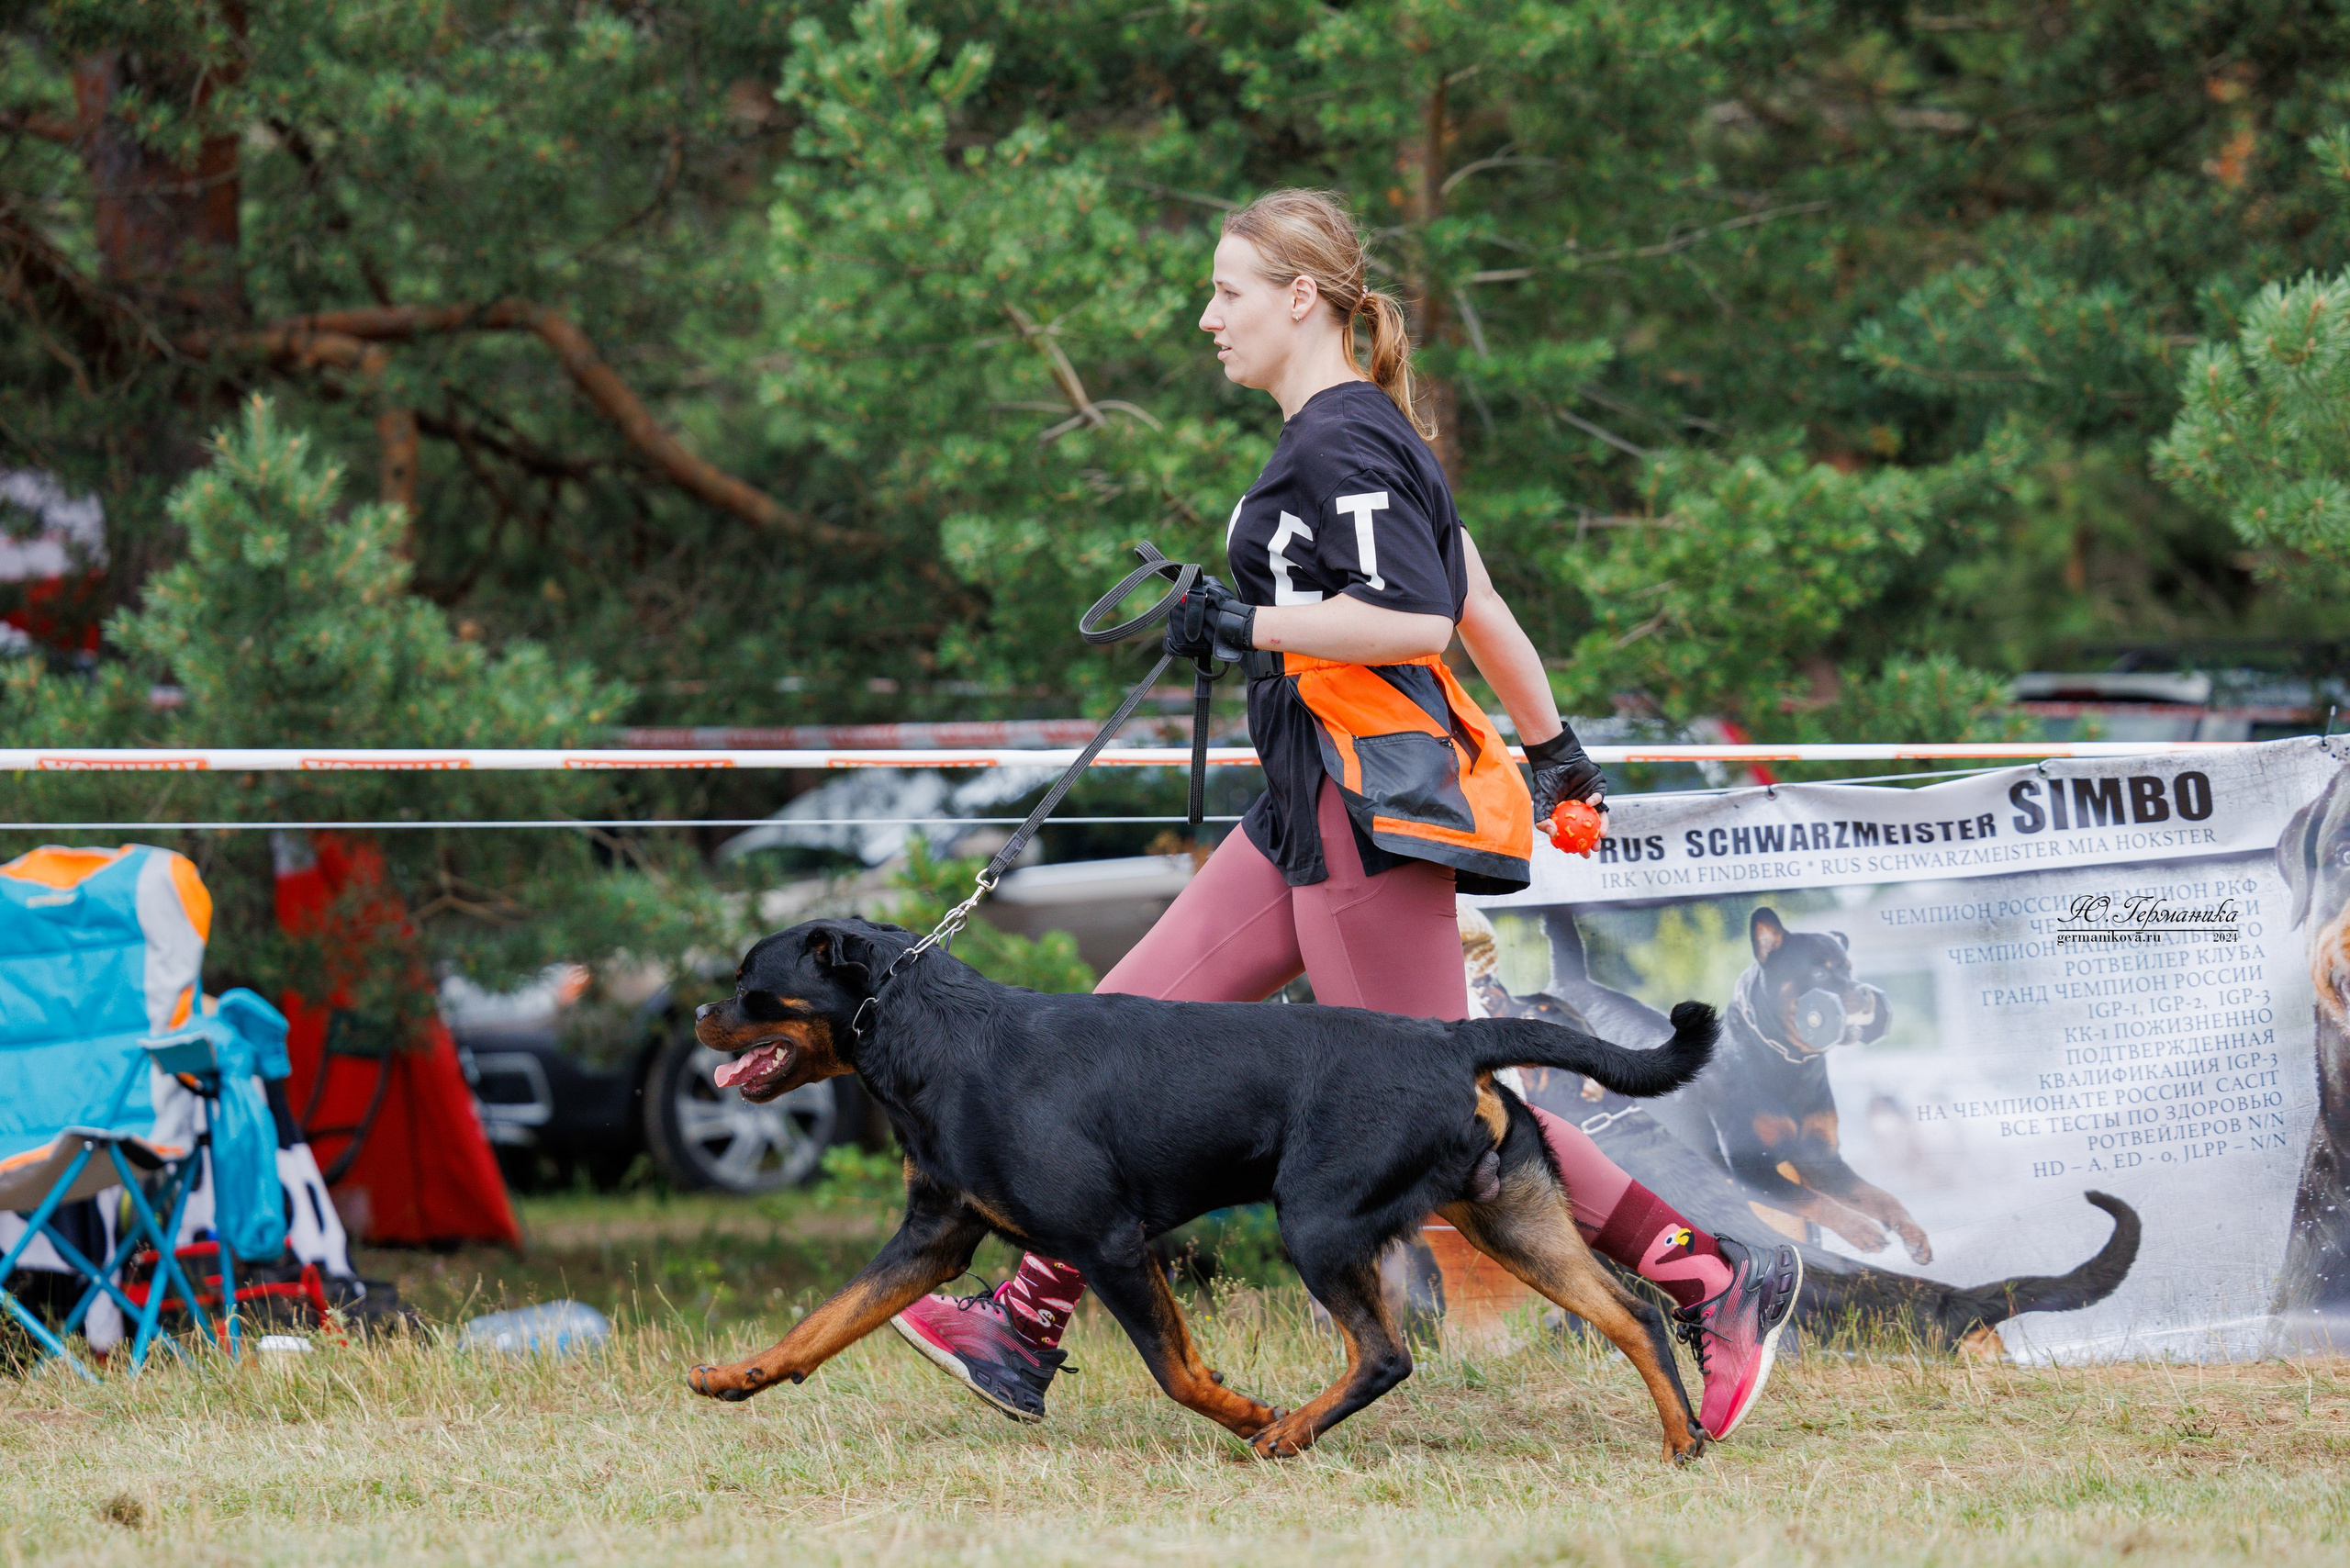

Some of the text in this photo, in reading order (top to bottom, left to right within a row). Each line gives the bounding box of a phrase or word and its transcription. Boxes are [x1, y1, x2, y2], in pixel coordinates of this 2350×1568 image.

[1226, 491, 1389, 606] ET
[1600, 770, 2213, 864] RUS SCHWARZMEISTER SIMBO
[1601, 828, 2217, 889] IRK VOM FINDBERG RUS SCHWARZMEISTER MIA HOKSTER
[1880, 902, 1991, 925] ЧЕМПИОН
[2215, 879, 2257, 897] РКФ
[1948, 940, 2056, 965] ЧЕМПИОН
[2065, 944, 2266, 976] РОТВЕЙЛЕР КЛУБА
[1982, 965, 2263, 1006] ГРАНД ЧЕМПИОН РОССИИ
[2149, 995, 2208, 1014] IGP-2,
[2219, 988, 2270, 1006] IGP-3
[2114, 1008, 2273, 1039] ПОЖИЗНЕННО
[2065, 1028, 2276, 1065] ПОДТВЕРЖДЕННАЯ
[2038, 1052, 2277, 1090] КВАЛИФИКАЦИЯ IGP-3
[1917, 1070, 2280, 1121] НА ЧЕМПИОНАТЕ РОССИИ CACIT
[2000, 1091, 2283, 1137] ВСЕ ТЕСТЫ ПО ЗДОРОВЬЮ
[2087, 1112, 2285, 1150] РОТВЕЙЛЕРОВ N/N
[2032, 1160, 2065, 1177] HD
[2087, 1158, 2107, 1171] A,
[2113, 1152, 2143, 1169] ED
[2184, 1140, 2227, 1163] JLPP
[2251, 1132, 2286, 1150] N/N
